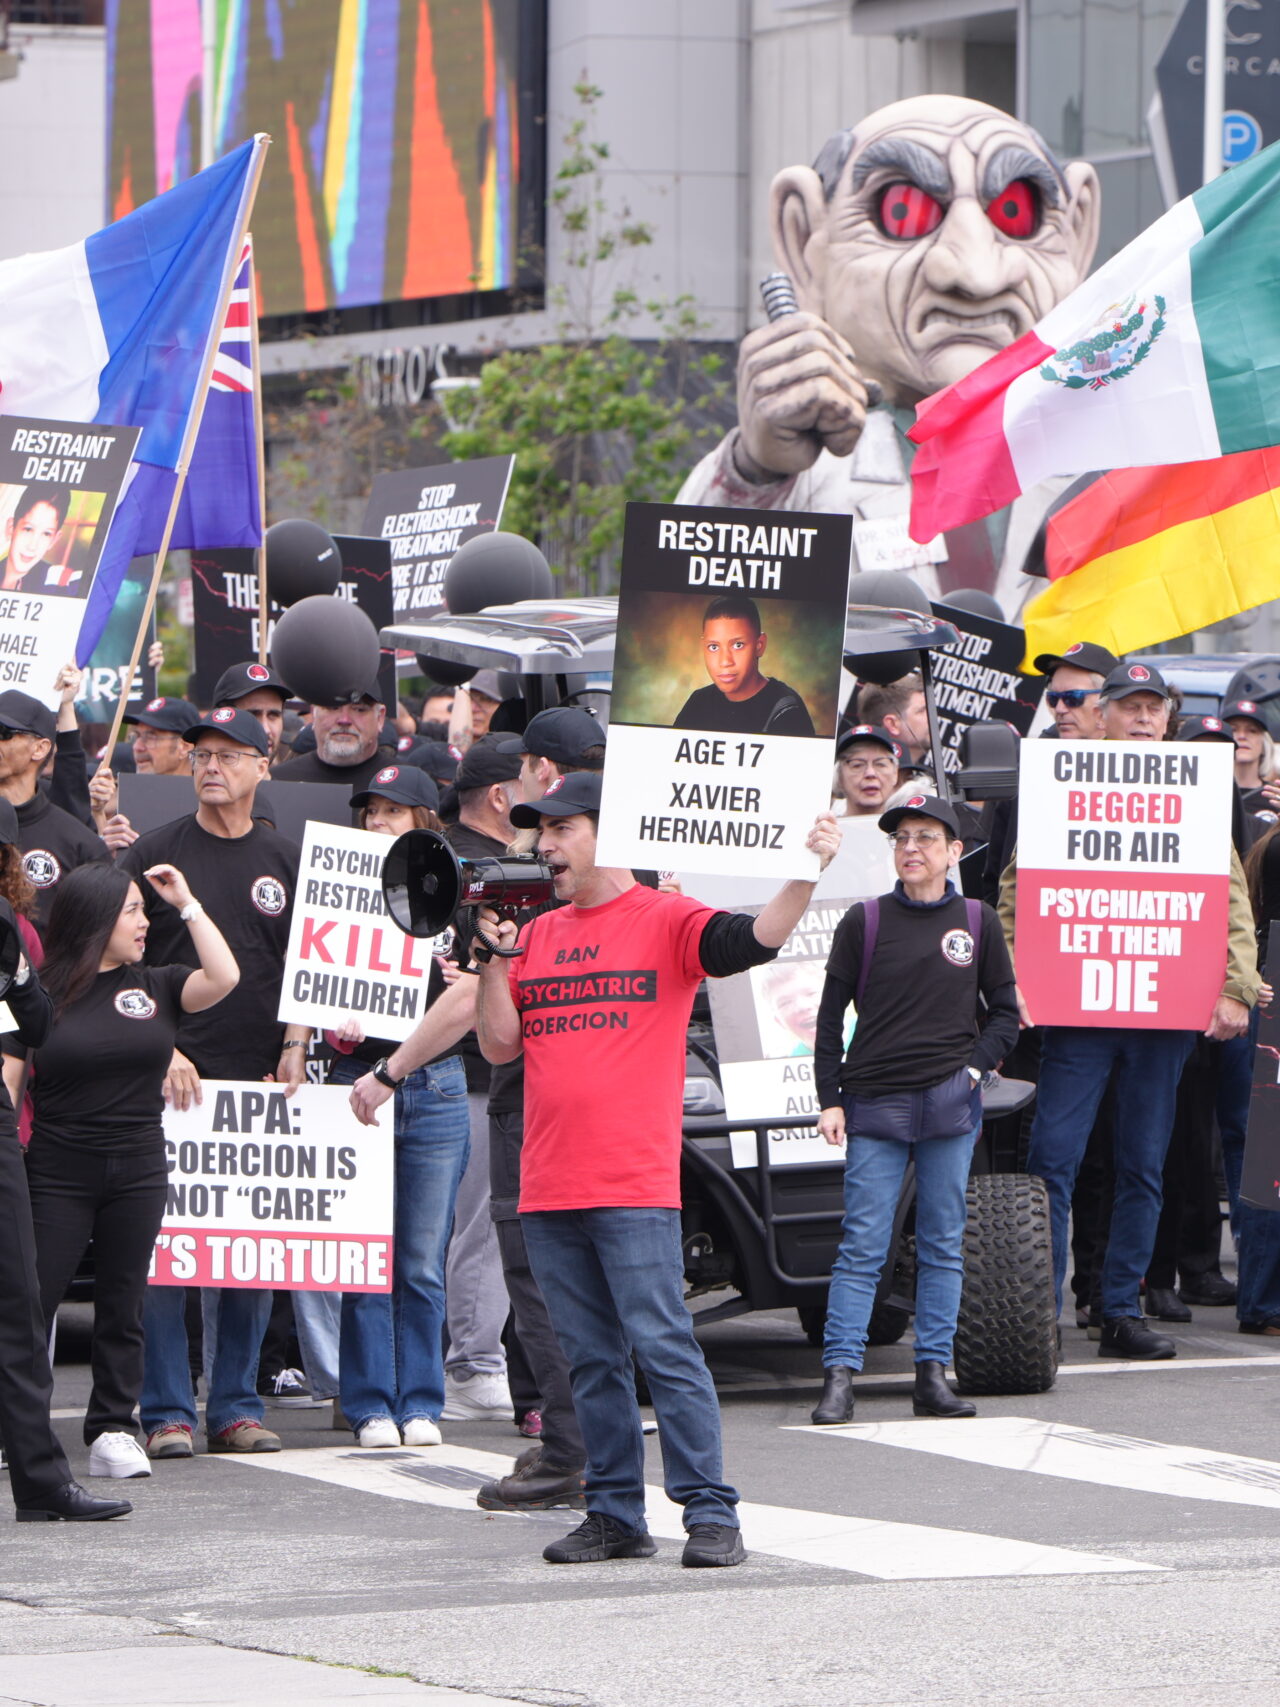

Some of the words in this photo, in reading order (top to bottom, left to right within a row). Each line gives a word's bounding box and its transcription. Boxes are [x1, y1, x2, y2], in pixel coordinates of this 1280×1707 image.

[11, 429, 116, 459] RESTRAINT
[22, 457, 87, 484] DEATH
[417, 483, 456, 510] STOP
[381, 502, 482, 538] ELECTROSHOCK
[658, 520, 818, 558] RESTRAINT
[688, 556, 782, 590] DEATH
[0, 598, 19, 619] GE
[24, 602, 43, 621] 12
[0, 633, 39, 656] HAEL
[674, 738, 726, 765] AGE
[735, 742, 765, 768] 17
[1054, 750, 1199, 786] CHILDREN
[669, 782, 761, 813] XAVIER
[1067, 790, 1182, 824] BEGGED
[639, 815, 785, 850] HERNANDIZ
[1067, 829, 1122, 862] FOR
[1129, 831, 1180, 863] AIR
[1039, 887, 1206, 921] PSYCHIATRY
[299, 917, 423, 978] KILL
[554, 945, 600, 965] BAN
[1059, 923, 1104, 953] LET
[1108, 925, 1182, 956] THEM
[293, 970, 419, 1019] CHILDREN
[1080, 959, 1159, 1013] DIE
[523, 1012, 628, 1039] COERCION
[782, 1064, 815, 1083] AG
[212, 1090, 302, 1135] APA:
[326, 1146, 357, 1180] IS
[166, 1183, 229, 1218] NOT
[206, 1235, 388, 1286] TORTURE
